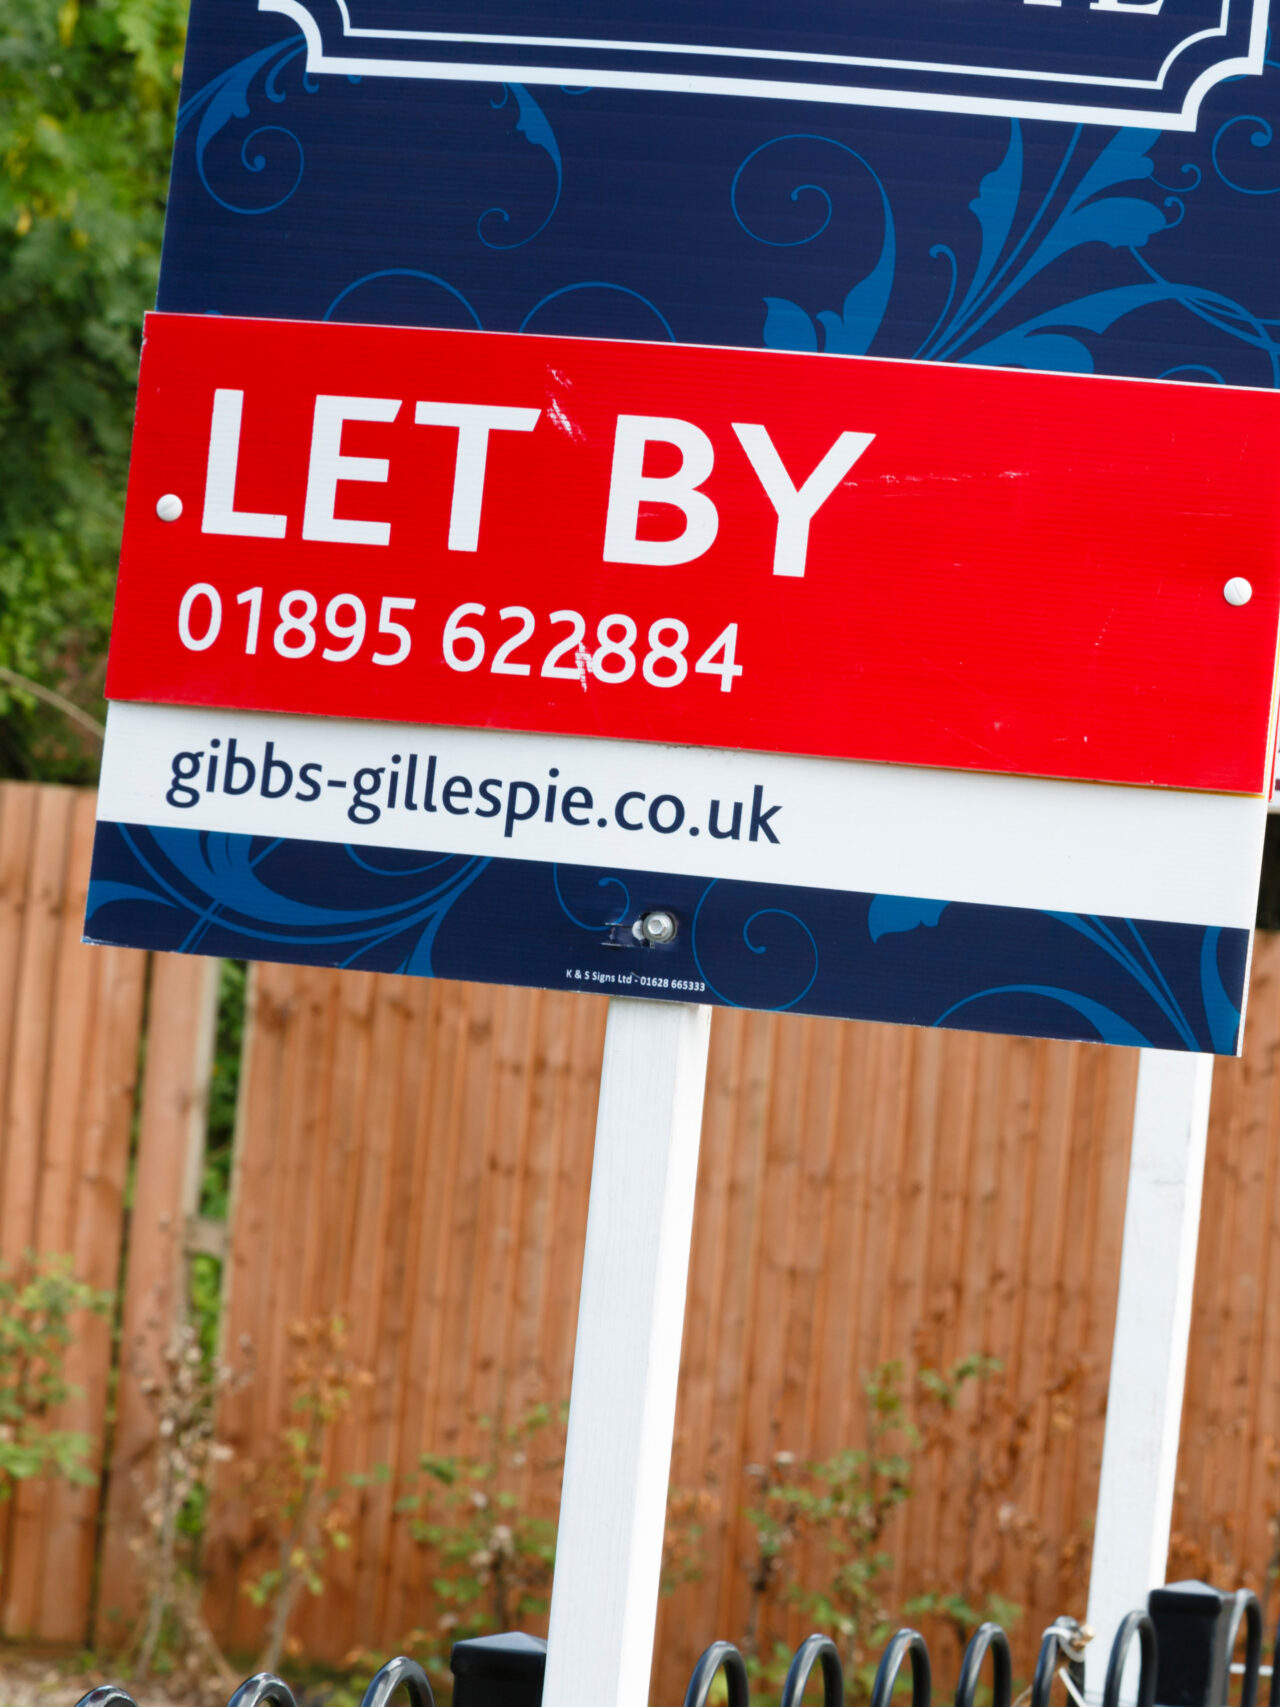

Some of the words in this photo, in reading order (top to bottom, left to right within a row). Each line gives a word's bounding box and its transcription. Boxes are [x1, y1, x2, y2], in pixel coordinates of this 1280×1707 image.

[202, 388, 542, 552] LET
[603, 413, 877, 579] BY
[177, 582, 417, 668] 01895
[442, 602, 744, 693] 622884
[165, 737, 784, 846] gibbs-gillespie.co.uk
[565, 969, 572, 979] K
[574, 969, 582, 980] &
[584, 970, 590, 980] S
[592, 971, 616, 983] Signs
[618, 974, 632, 985] Ltd
[640, 976, 669, 988] 01628
[671, 979, 706, 992] 665333
